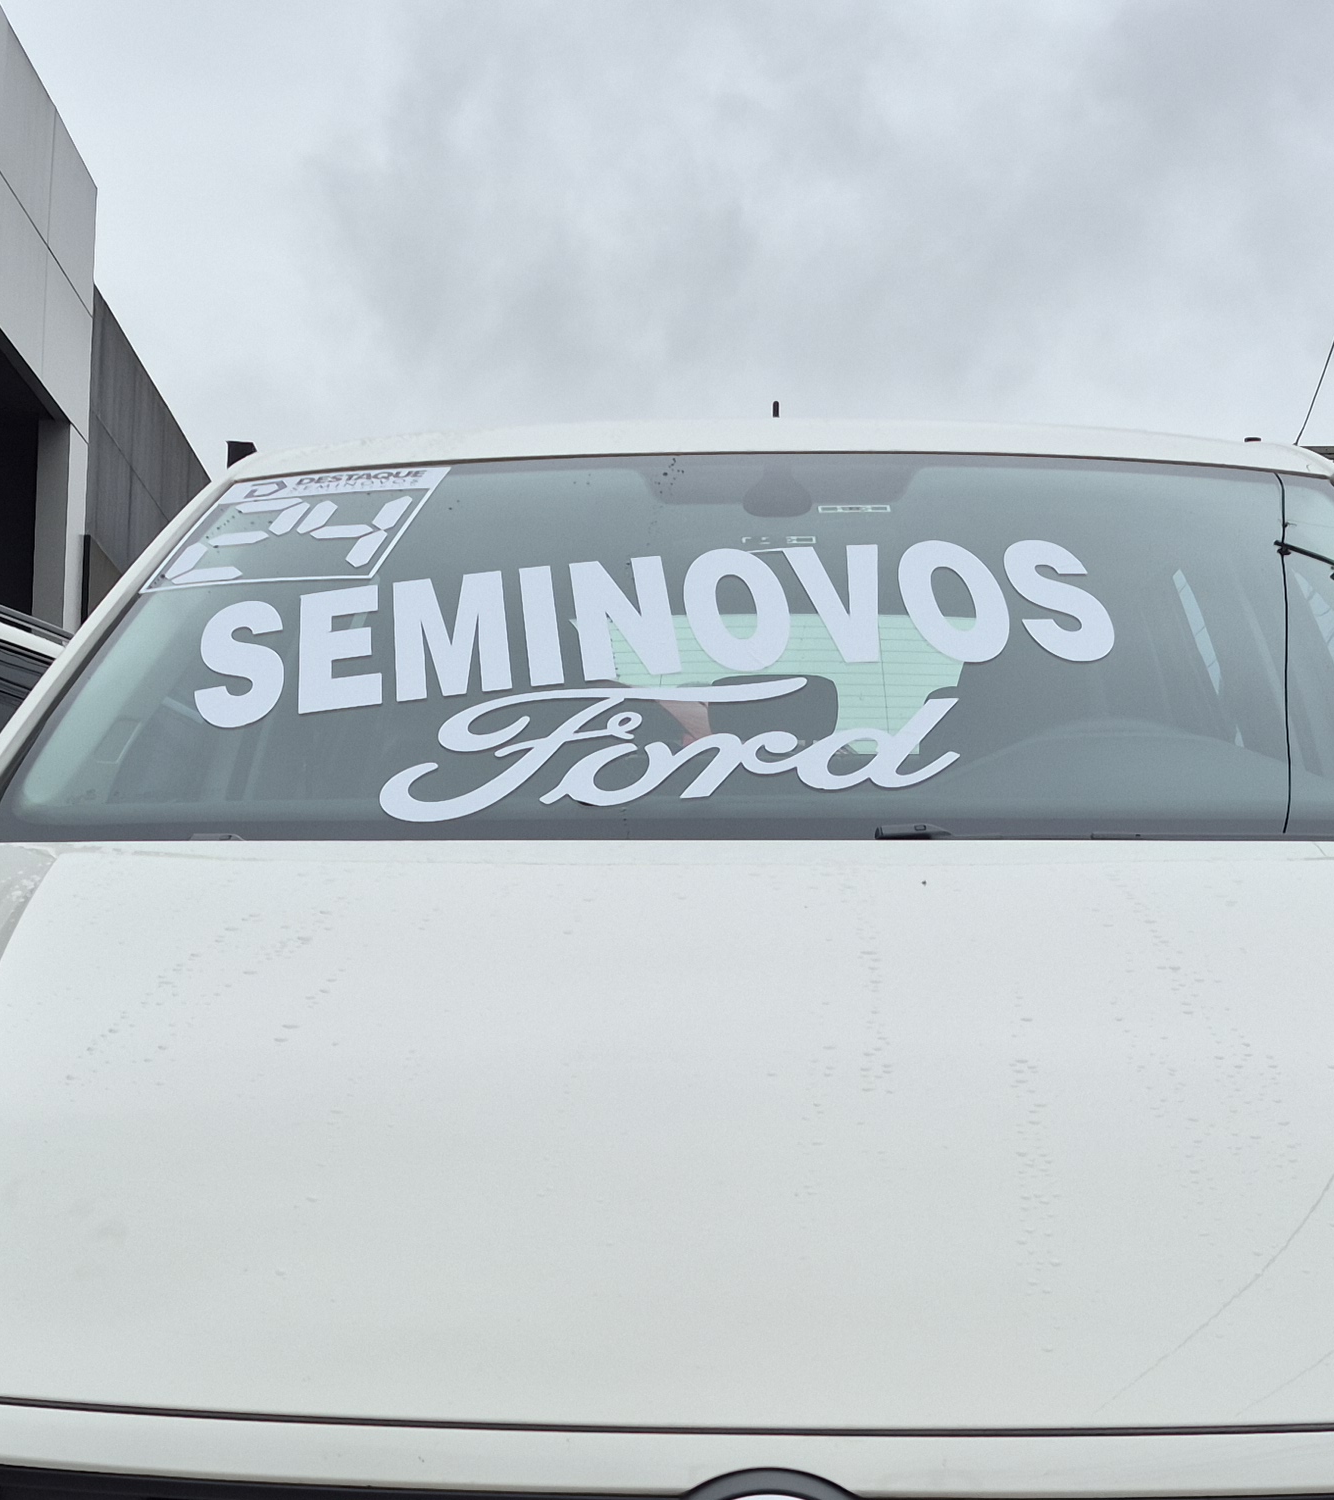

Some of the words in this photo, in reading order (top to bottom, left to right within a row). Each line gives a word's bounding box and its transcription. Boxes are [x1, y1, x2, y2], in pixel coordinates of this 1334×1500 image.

[297, 470, 427, 486] DESTAQUE
[194, 539, 1116, 729] SEMINOVOS
[378, 676, 961, 823] Ford
